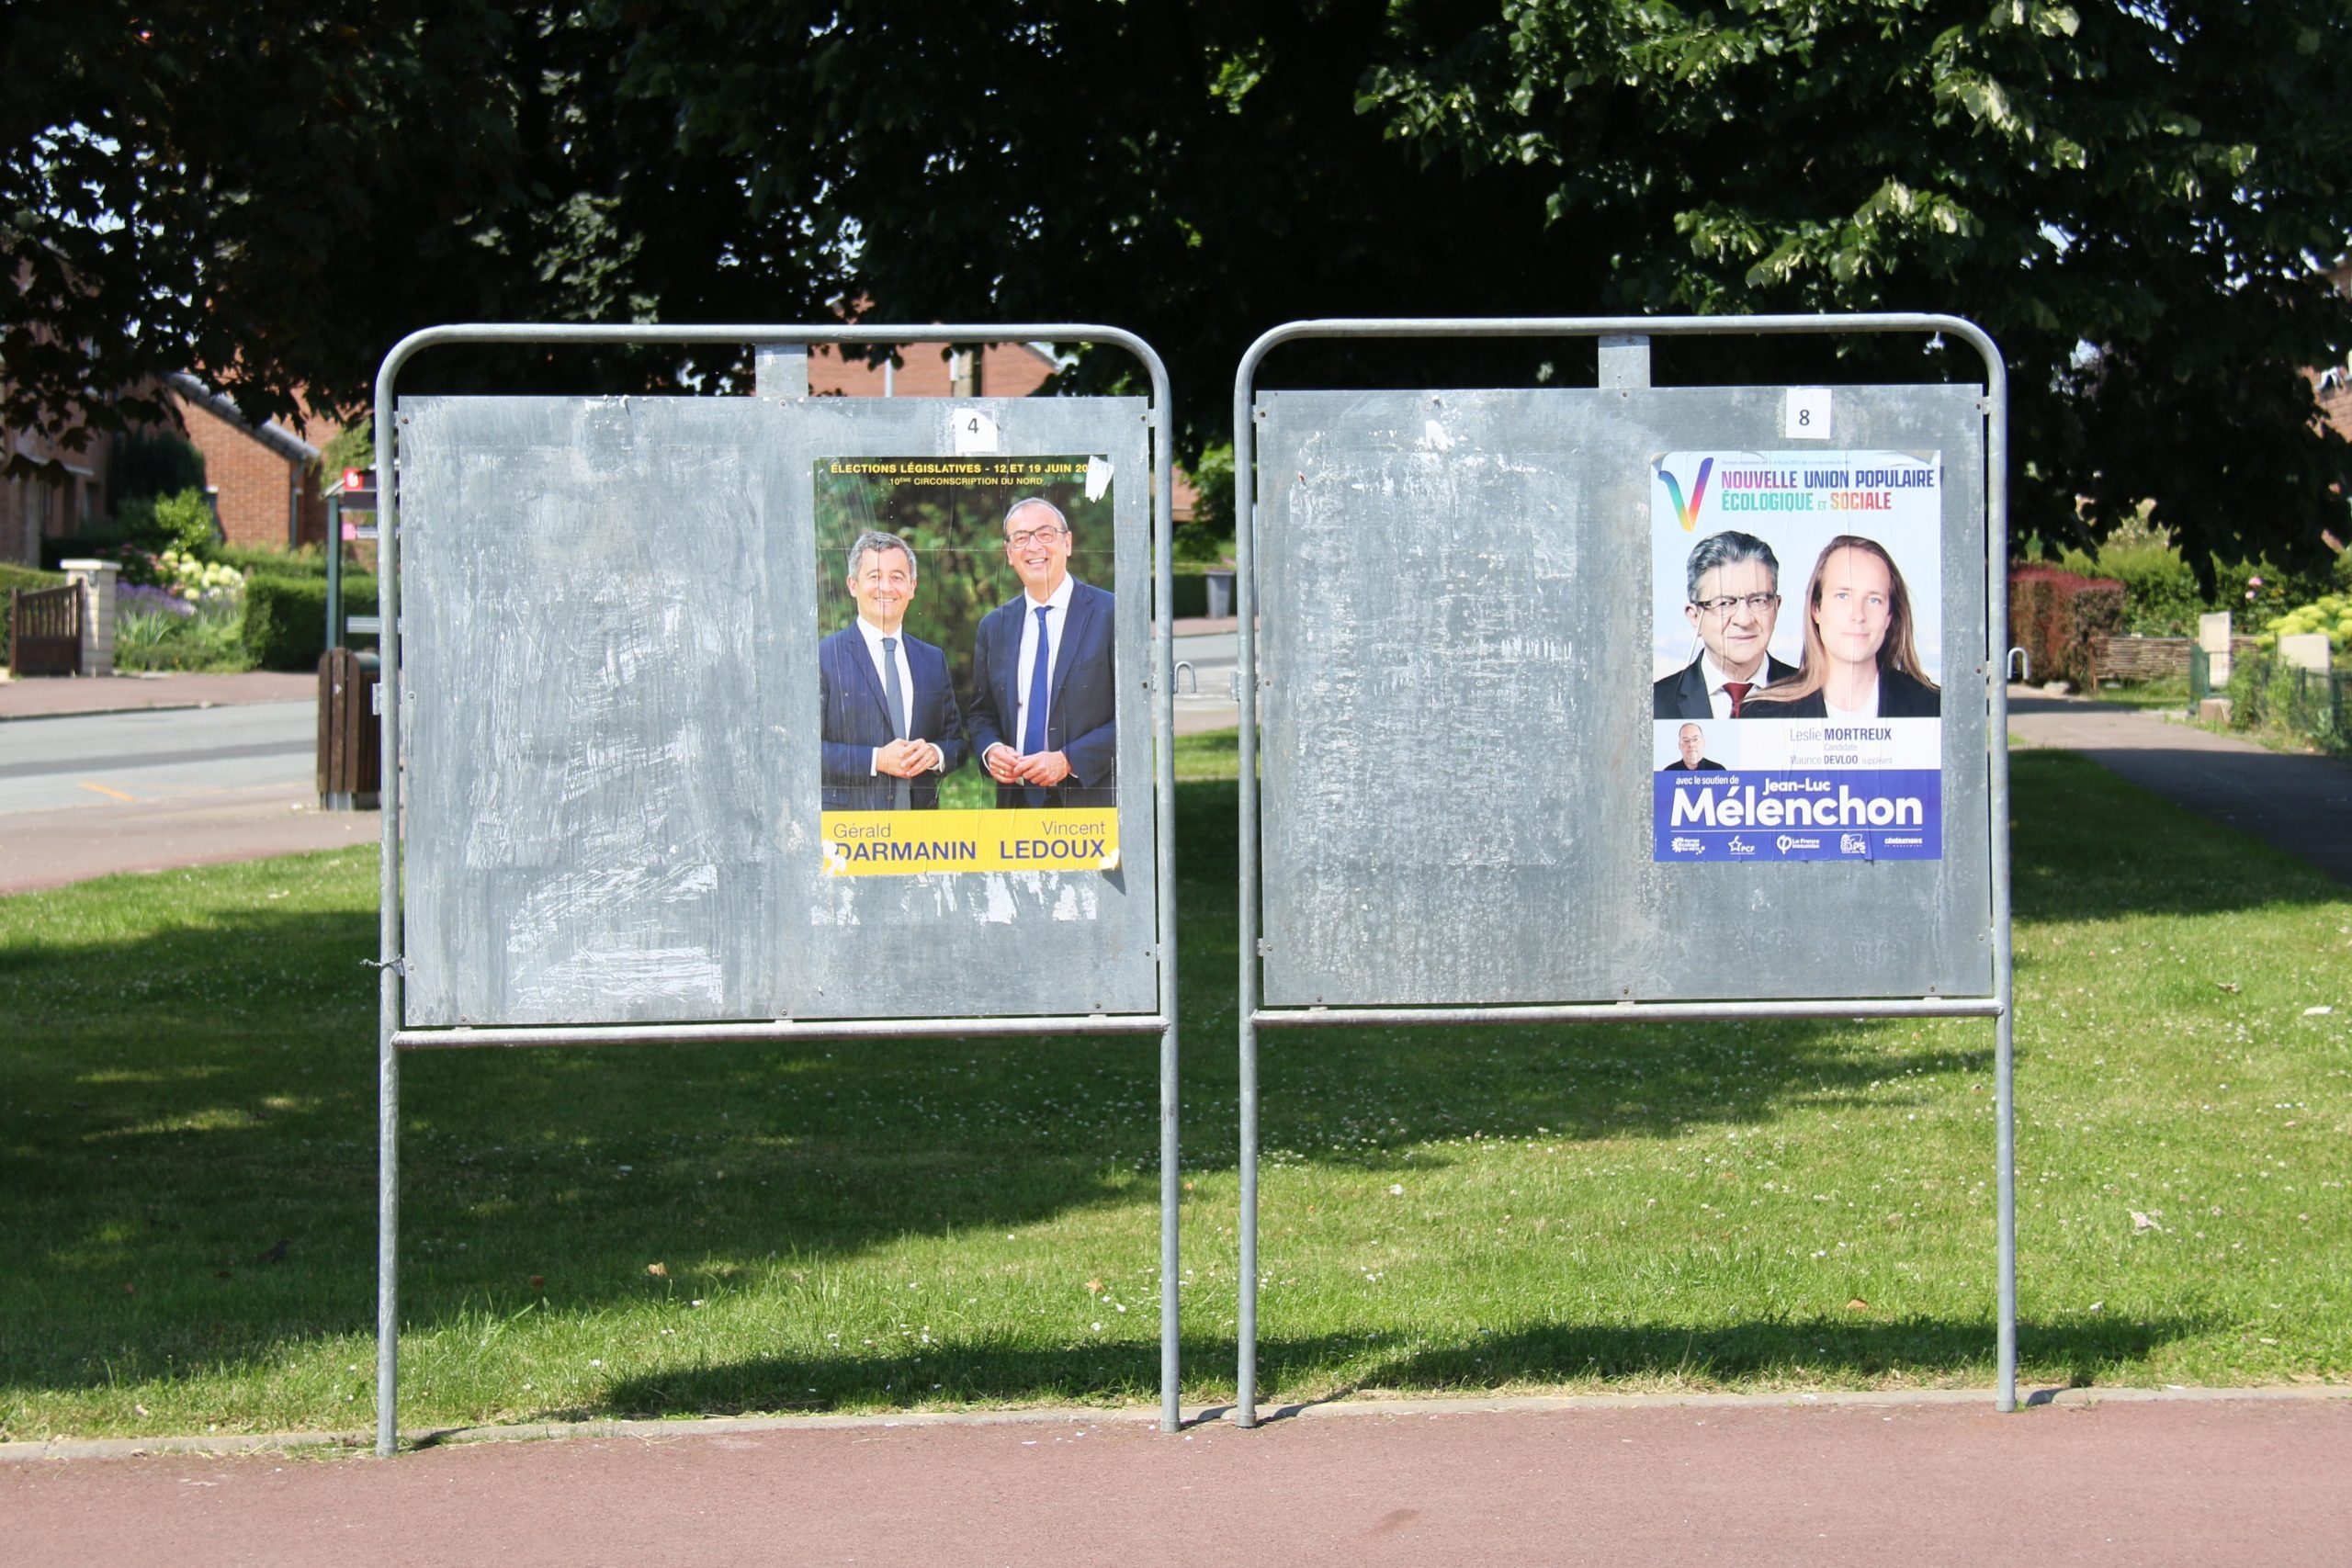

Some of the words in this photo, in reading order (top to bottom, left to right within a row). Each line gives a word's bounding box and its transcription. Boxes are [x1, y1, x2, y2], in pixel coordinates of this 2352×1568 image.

[967, 417, 979, 434] 4
[1799, 409, 1810, 426] 8
[831, 461, 897, 474] ÉLECTIONS
[900, 461, 981, 473] LÉGISLATIVES
[994, 464, 1008, 473] 12
[1010, 464, 1024, 473] ET
[1028, 464, 1042, 473] 19
[1045, 464, 1072, 473] JUIN
[913, 478, 999, 486] CIRCONSCRIPTION
[1001, 478, 1011, 486] DU
[1016, 478, 1043, 486] NORD
[1721, 470, 1798, 490] NOUVELLE
[1804, 469, 1849, 490] UNION
[1855, 468, 1935, 489] POPULAIRE
[1721, 490, 1814, 513] ÉCOLOGIQUE
[1817, 501, 1826, 511] ET
[1830, 492, 1892, 511] SOCIALE
[1790, 728, 1822, 741] Leslie
[1824, 728, 1892, 741] MORTREUX
[1824, 742, 1858, 751] Candidate
[1824, 755, 1859, 765] DEVLOO
[1676, 777, 1693, 785] avec
[1694, 775, 1701, 785] le
[1702, 775, 1728, 785] soutien
[1729, 775, 1739, 784] de
[1762, 777, 1831, 796] Jean-Luc
[1670, 785, 1923, 827] Mélenchon
[833, 822, 891, 839] Gérald
[1042, 820, 1106, 835] Vincent
[837, 841, 977, 862] DARMANIN
[1000, 839, 1105, 860] LEDOUX
[1853, 842, 1866, 851] PS
